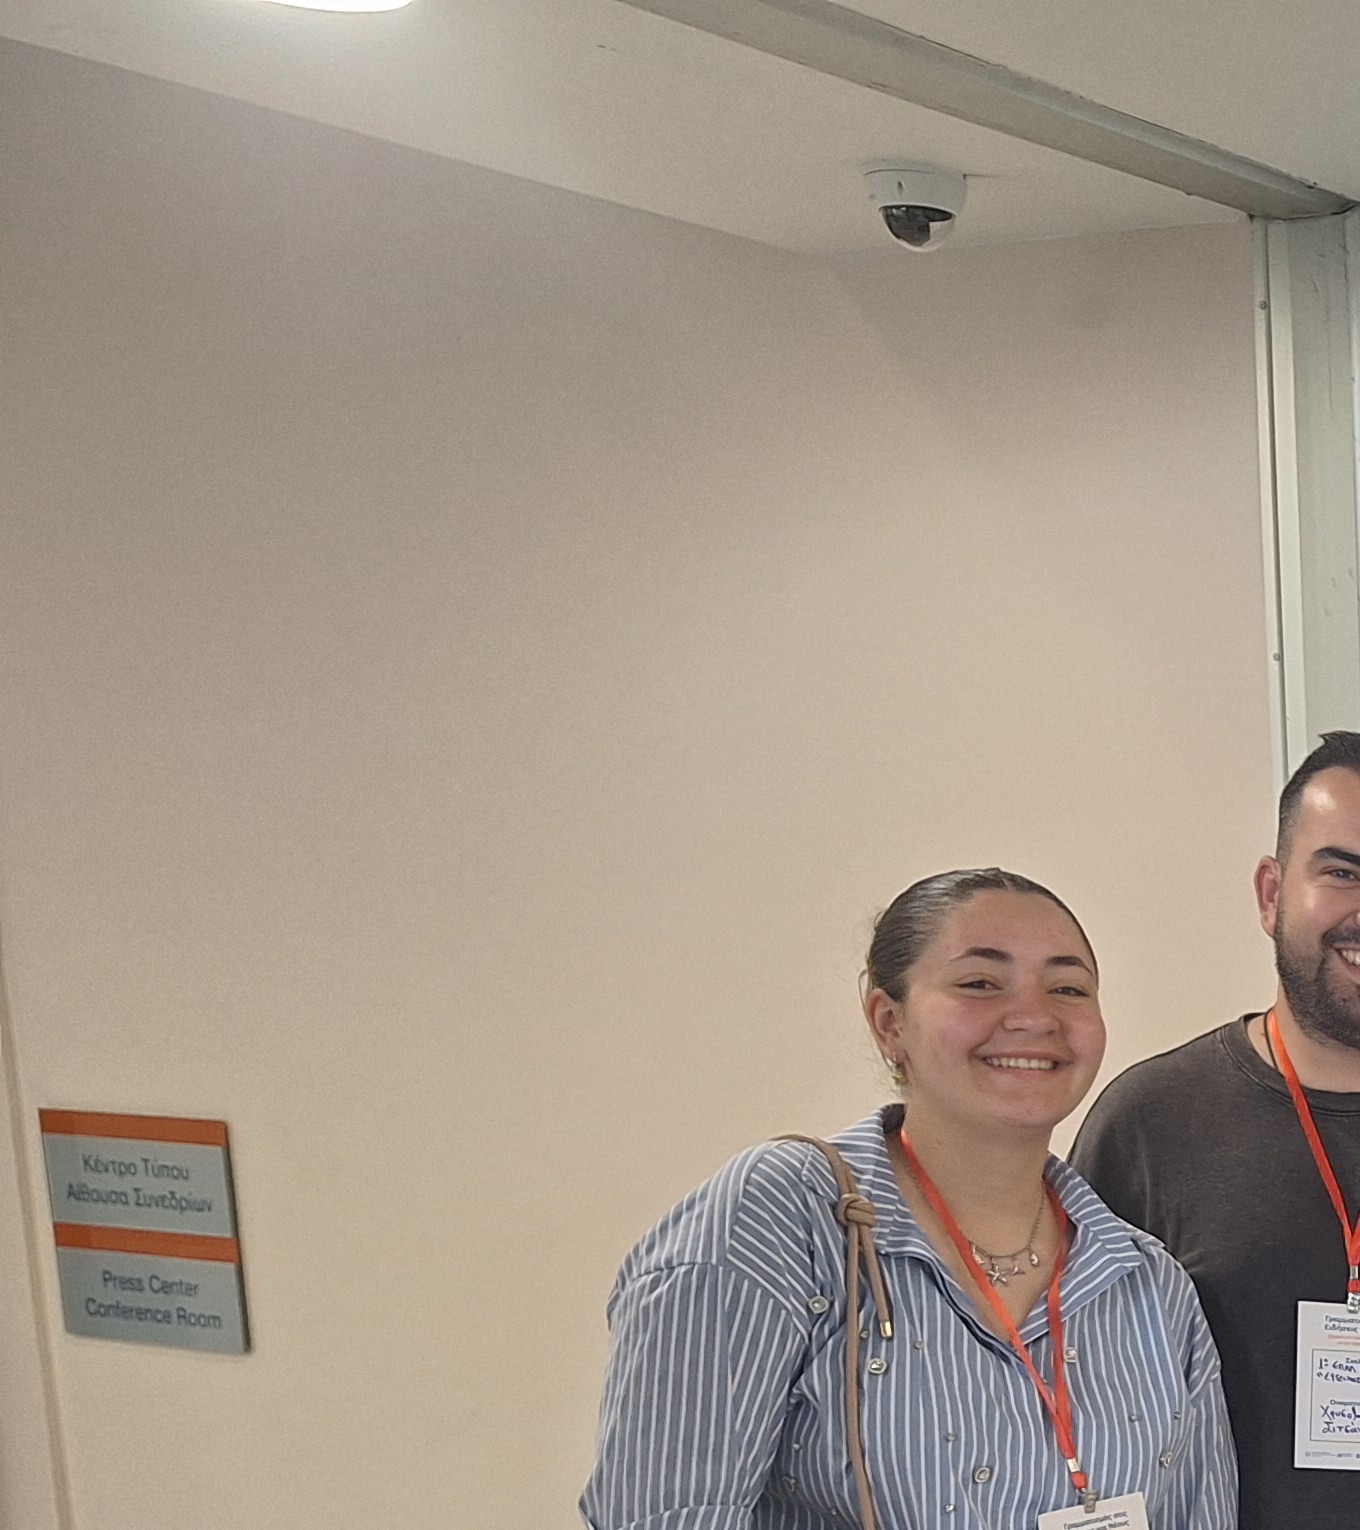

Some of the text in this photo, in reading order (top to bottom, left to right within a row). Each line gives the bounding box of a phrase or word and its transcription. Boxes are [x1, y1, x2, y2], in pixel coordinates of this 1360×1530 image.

[82, 1153, 190, 1180] Κέντρο Τύπου
[66, 1182, 213, 1214] Αίθουσα Συνεδρίων
[102, 1270, 199, 1296] Press Center
[86, 1298, 222, 1329] Conference Room
